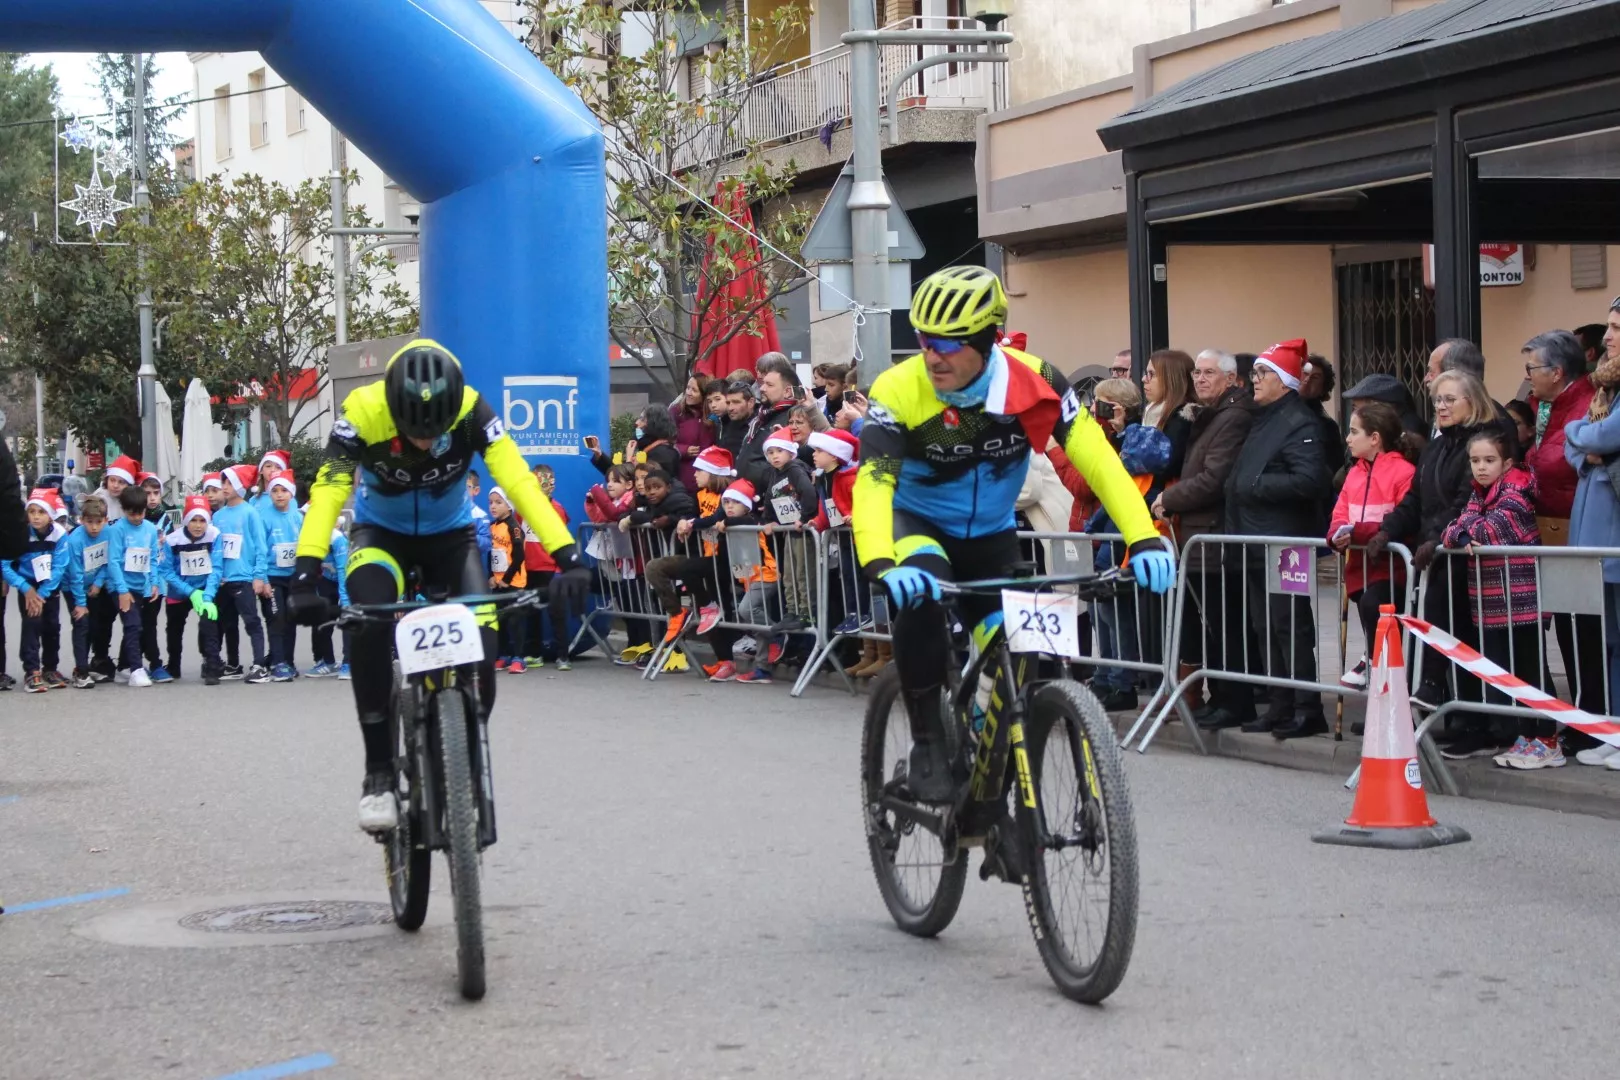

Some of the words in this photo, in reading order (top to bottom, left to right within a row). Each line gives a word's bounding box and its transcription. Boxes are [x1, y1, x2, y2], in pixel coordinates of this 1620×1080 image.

[503, 388, 579, 431] bnf
[511, 432, 579, 440] YUNTAMIENTO
[926, 433, 1027, 454] AGON
[778, 504, 796, 516] 294
[88, 548, 104, 562] 144
[185, 557, 205, 568] 112
[1281, 570, 1308, 584] ALCO
[1019, 609, 1062, 635] 233
[411, 620, 464, 652] 225
